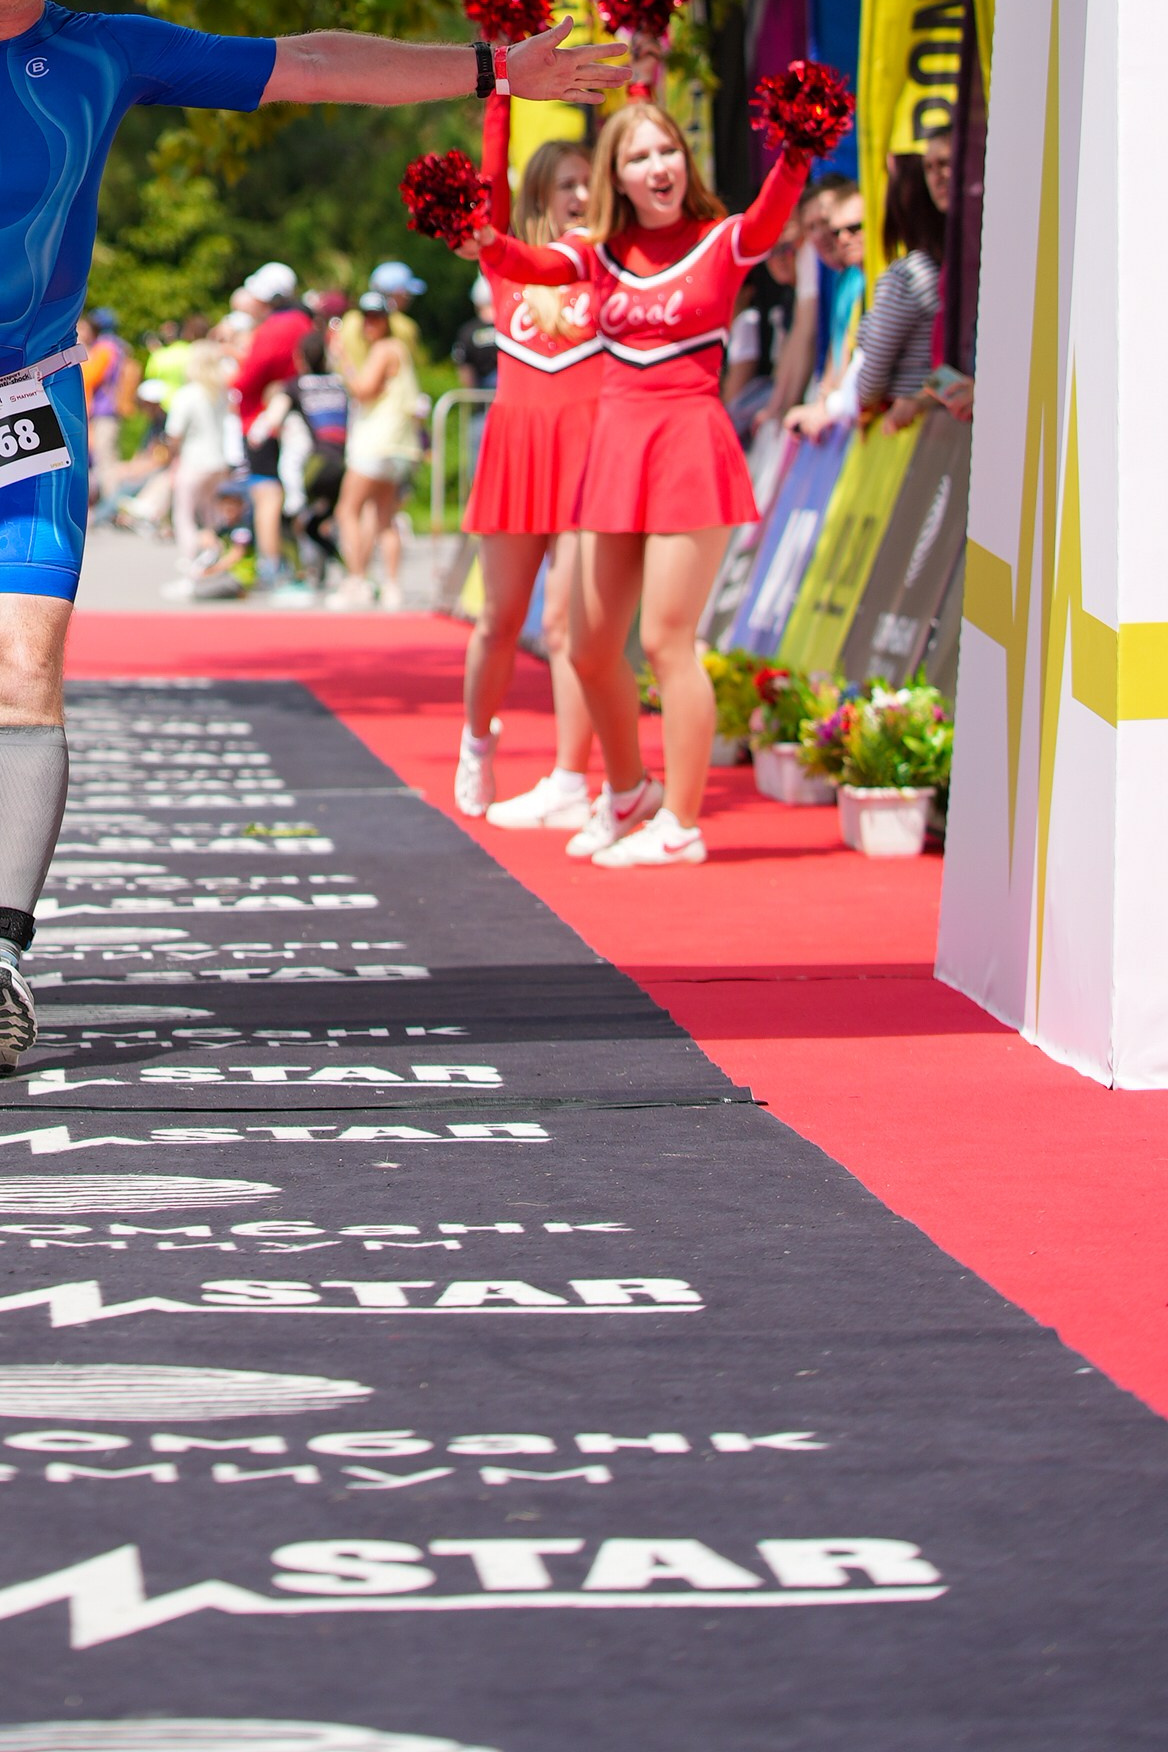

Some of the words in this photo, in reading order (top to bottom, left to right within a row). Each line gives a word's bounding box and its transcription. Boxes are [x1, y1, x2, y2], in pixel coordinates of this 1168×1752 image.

[599, 289, 684, 336] Cool
[125, 964, 432, 982] STAR
[139, 1064, 503, 1084] STAR
[150, 1122, 550, 1142] STAR
[199, 1277, 704, 1306] STAR
[269, 1536, 946, 1596] STAR
